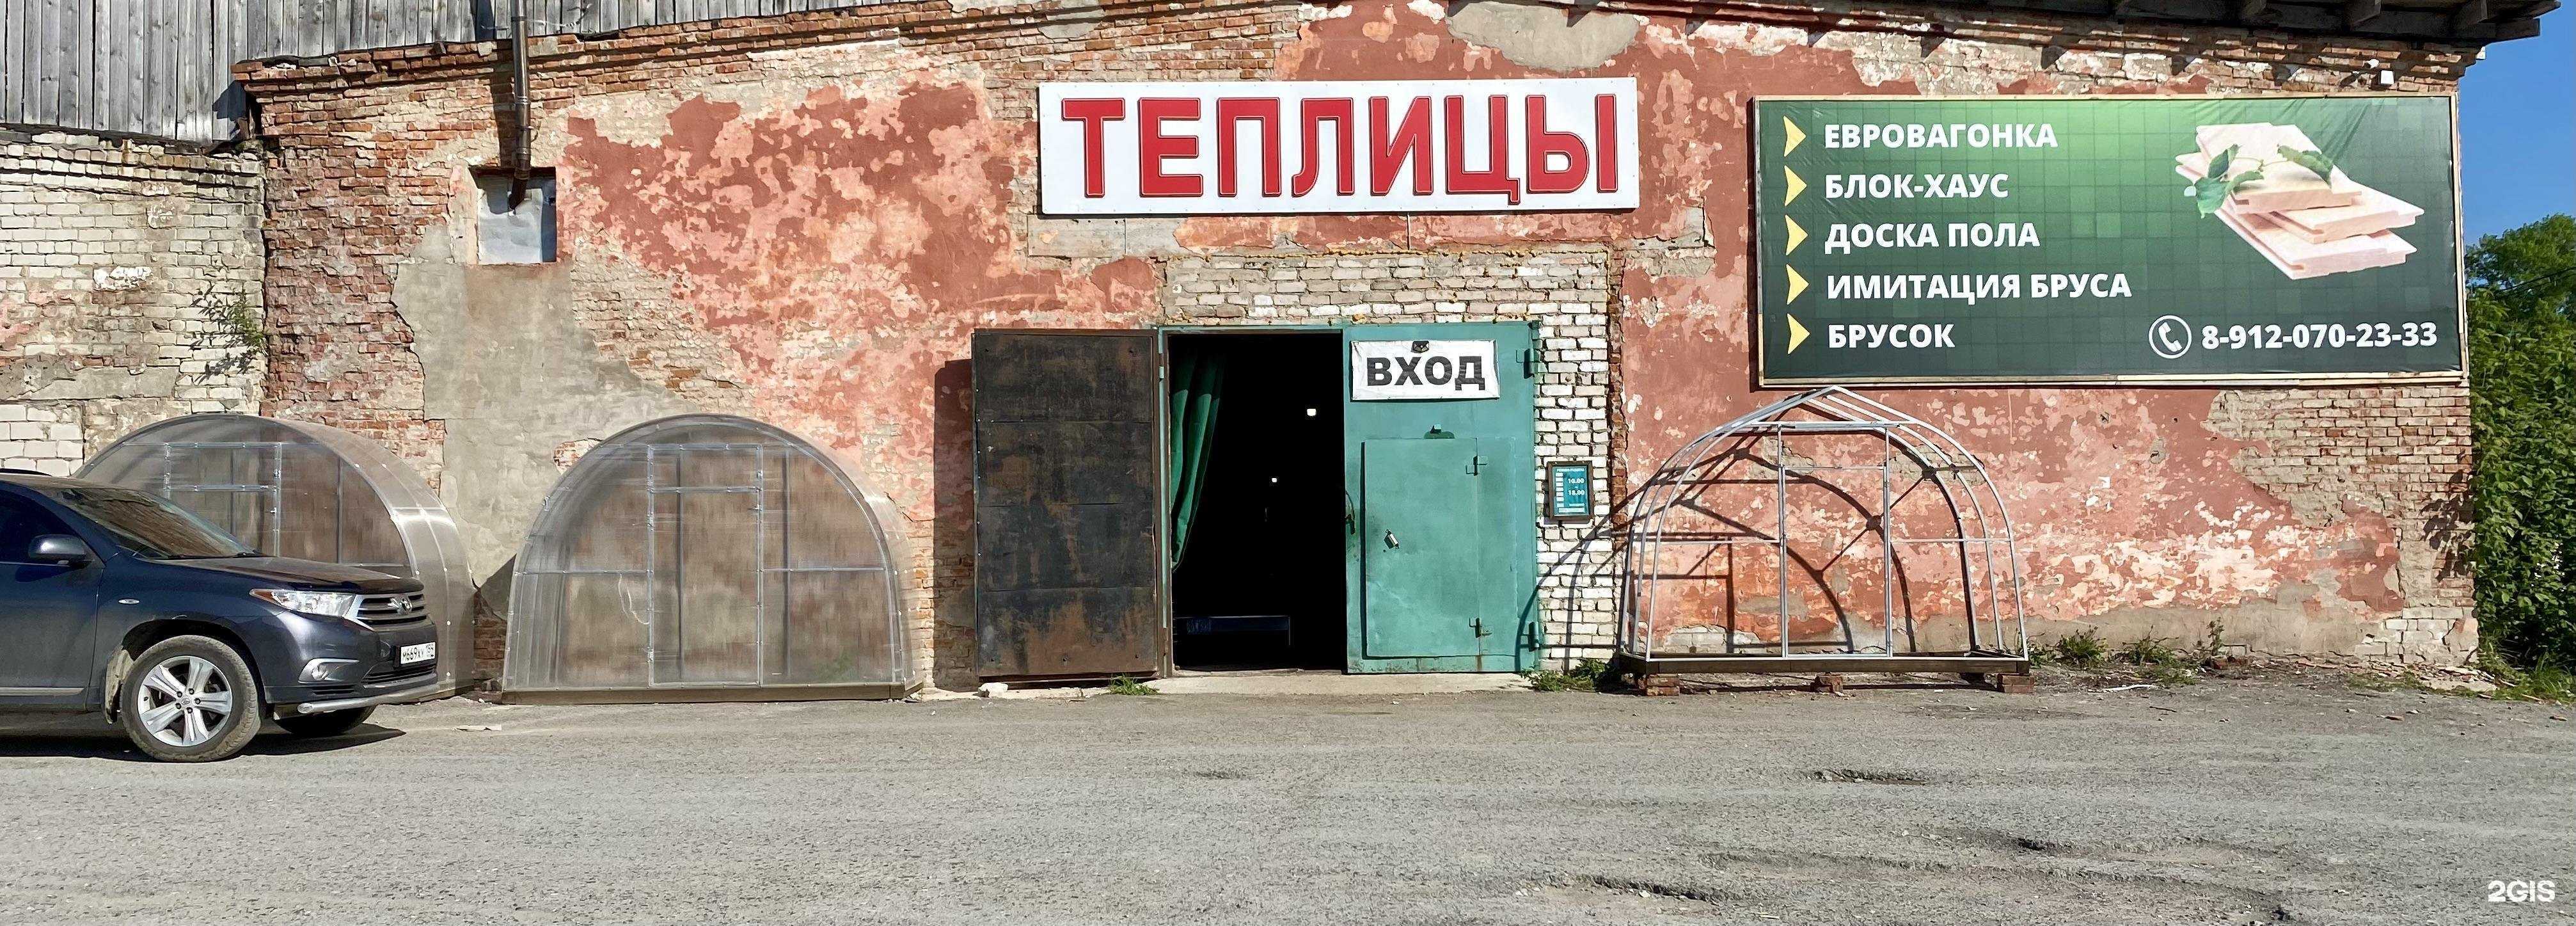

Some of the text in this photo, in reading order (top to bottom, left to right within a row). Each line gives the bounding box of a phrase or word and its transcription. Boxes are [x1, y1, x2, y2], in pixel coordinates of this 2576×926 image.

[1061, 94, 1616, 205] ТЕПЛИЦЫ
[1824, 124, 2058, 149] ЕВРОВАГОНКА
[1825, 173, 2009, 199] БЛОК-ХАУС
[1824, 223, 2041, 254] ДОСКА ПОЛА
[1828, 274, 2132, 305] ИМИТАЦИЯ БРУСА
[1828, 324, 1955, 348] БРУСОК
[2202, 323, 2438, 350] 8-912-070-23-33
[1366, 356, 1485, 391] ВХОД
